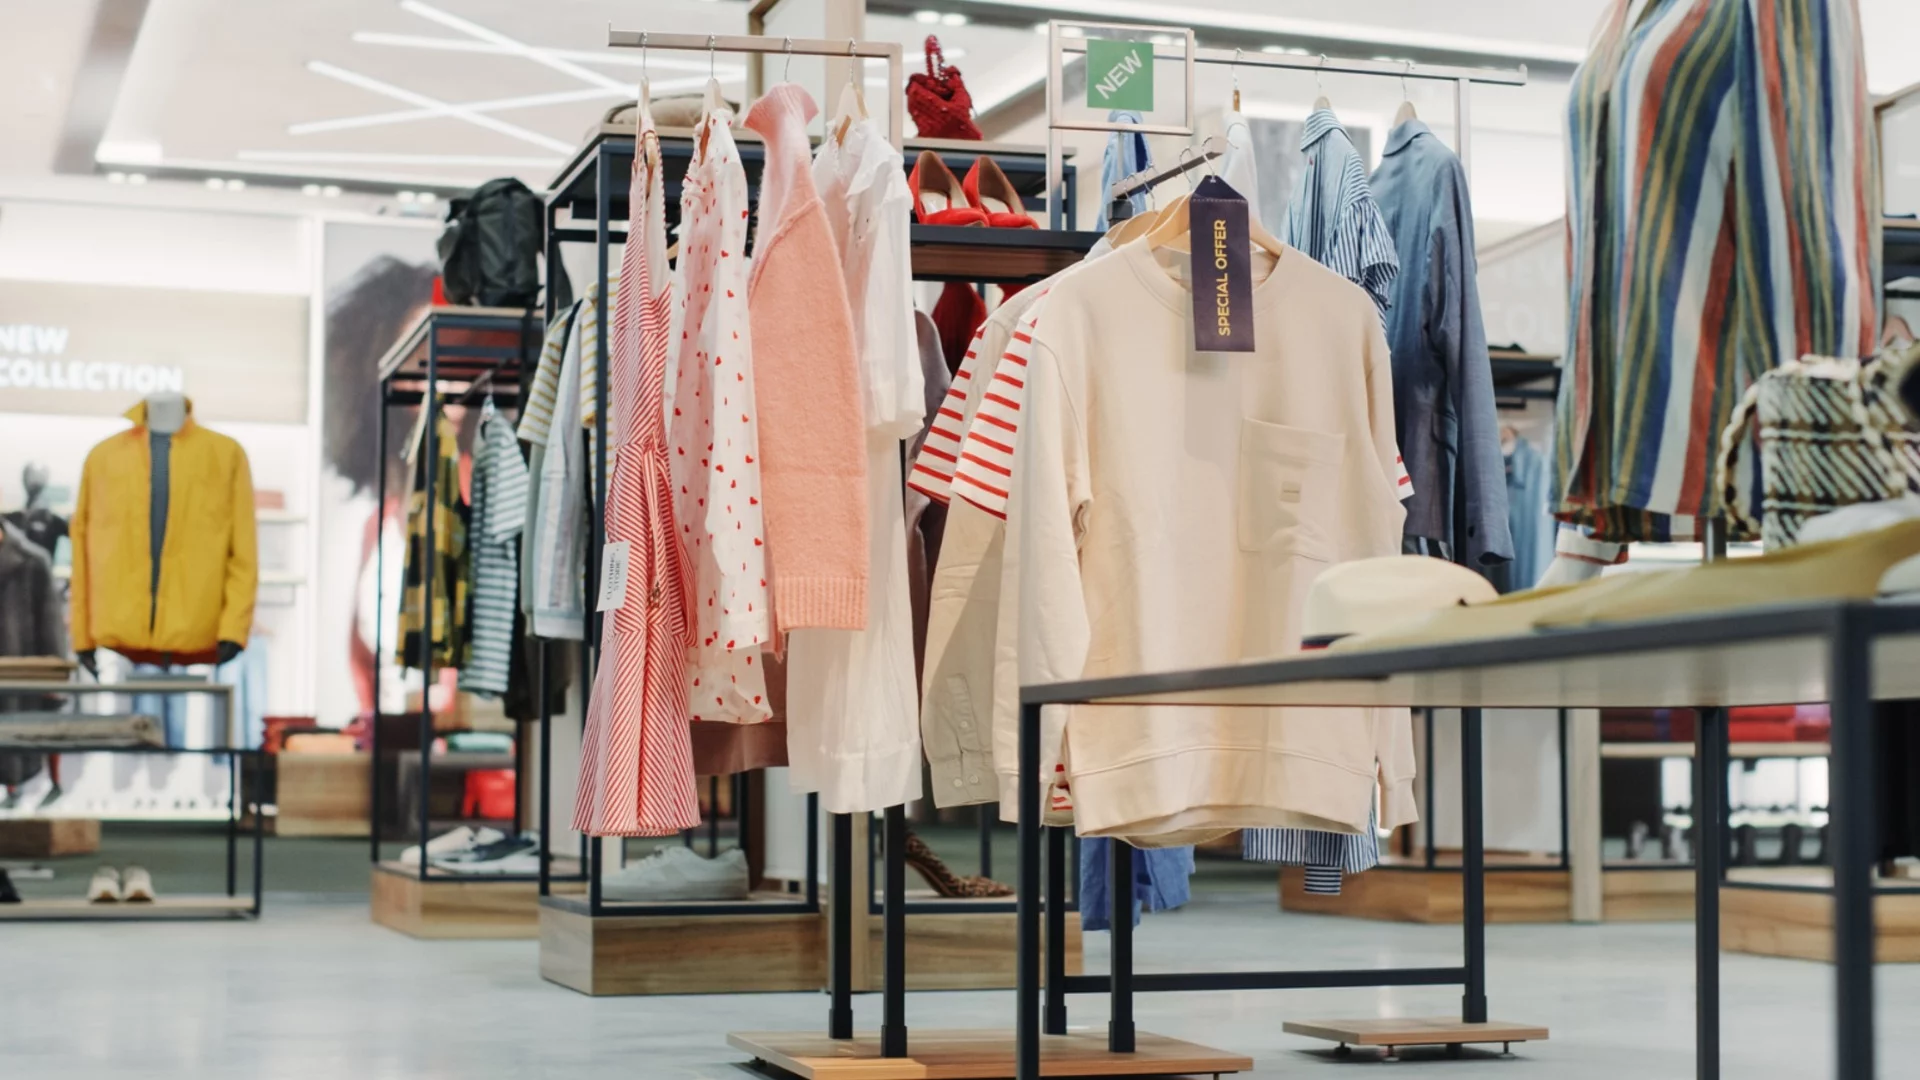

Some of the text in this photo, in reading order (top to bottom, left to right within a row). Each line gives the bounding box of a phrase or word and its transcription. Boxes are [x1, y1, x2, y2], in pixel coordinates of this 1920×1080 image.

[1095, 49, 1142, 99] NEW
[1214, 219, 1231, 336] SPECIAL OFFER
[0, 324, 69, 354] NEW
